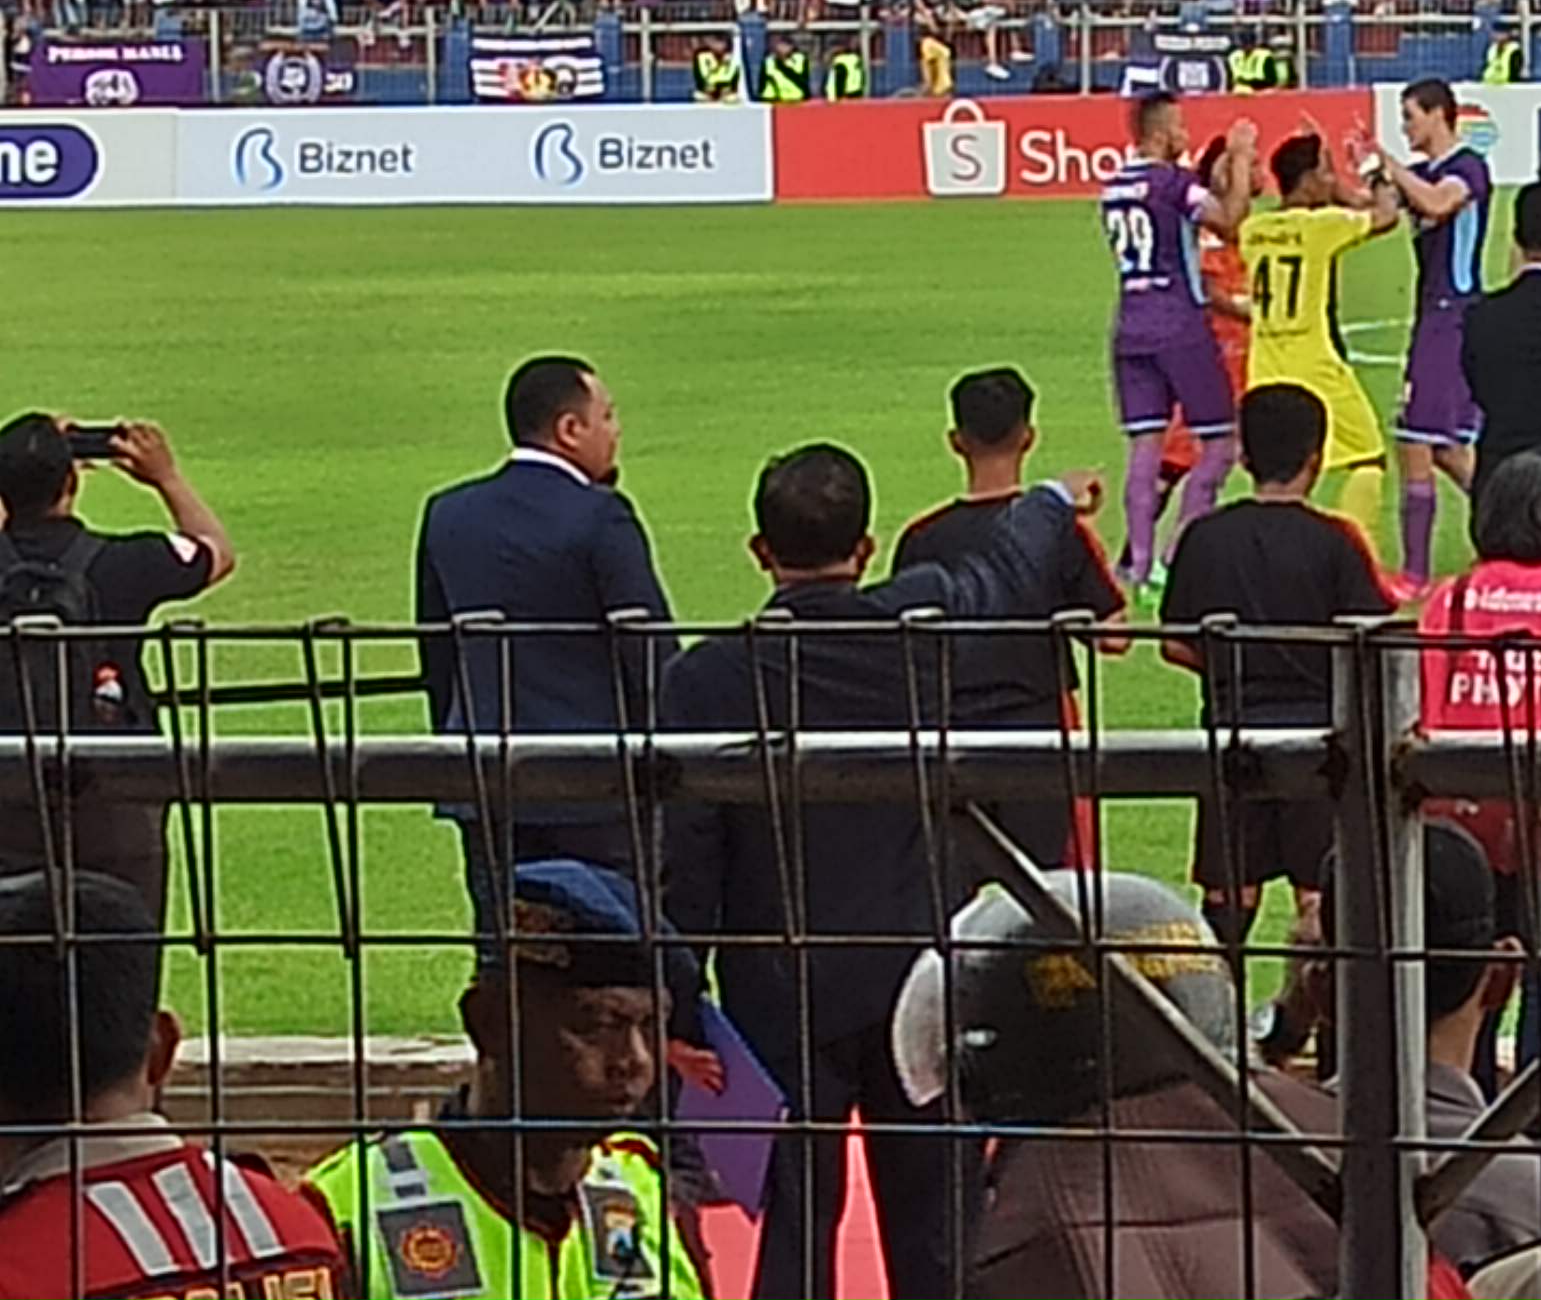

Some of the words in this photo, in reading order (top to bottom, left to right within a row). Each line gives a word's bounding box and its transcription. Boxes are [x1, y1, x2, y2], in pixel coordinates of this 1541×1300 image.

[298, 142, 414, 175] Biznet
[598, 136, 715, 170] Biznet
[1253, 254, 1303, 319] 47
